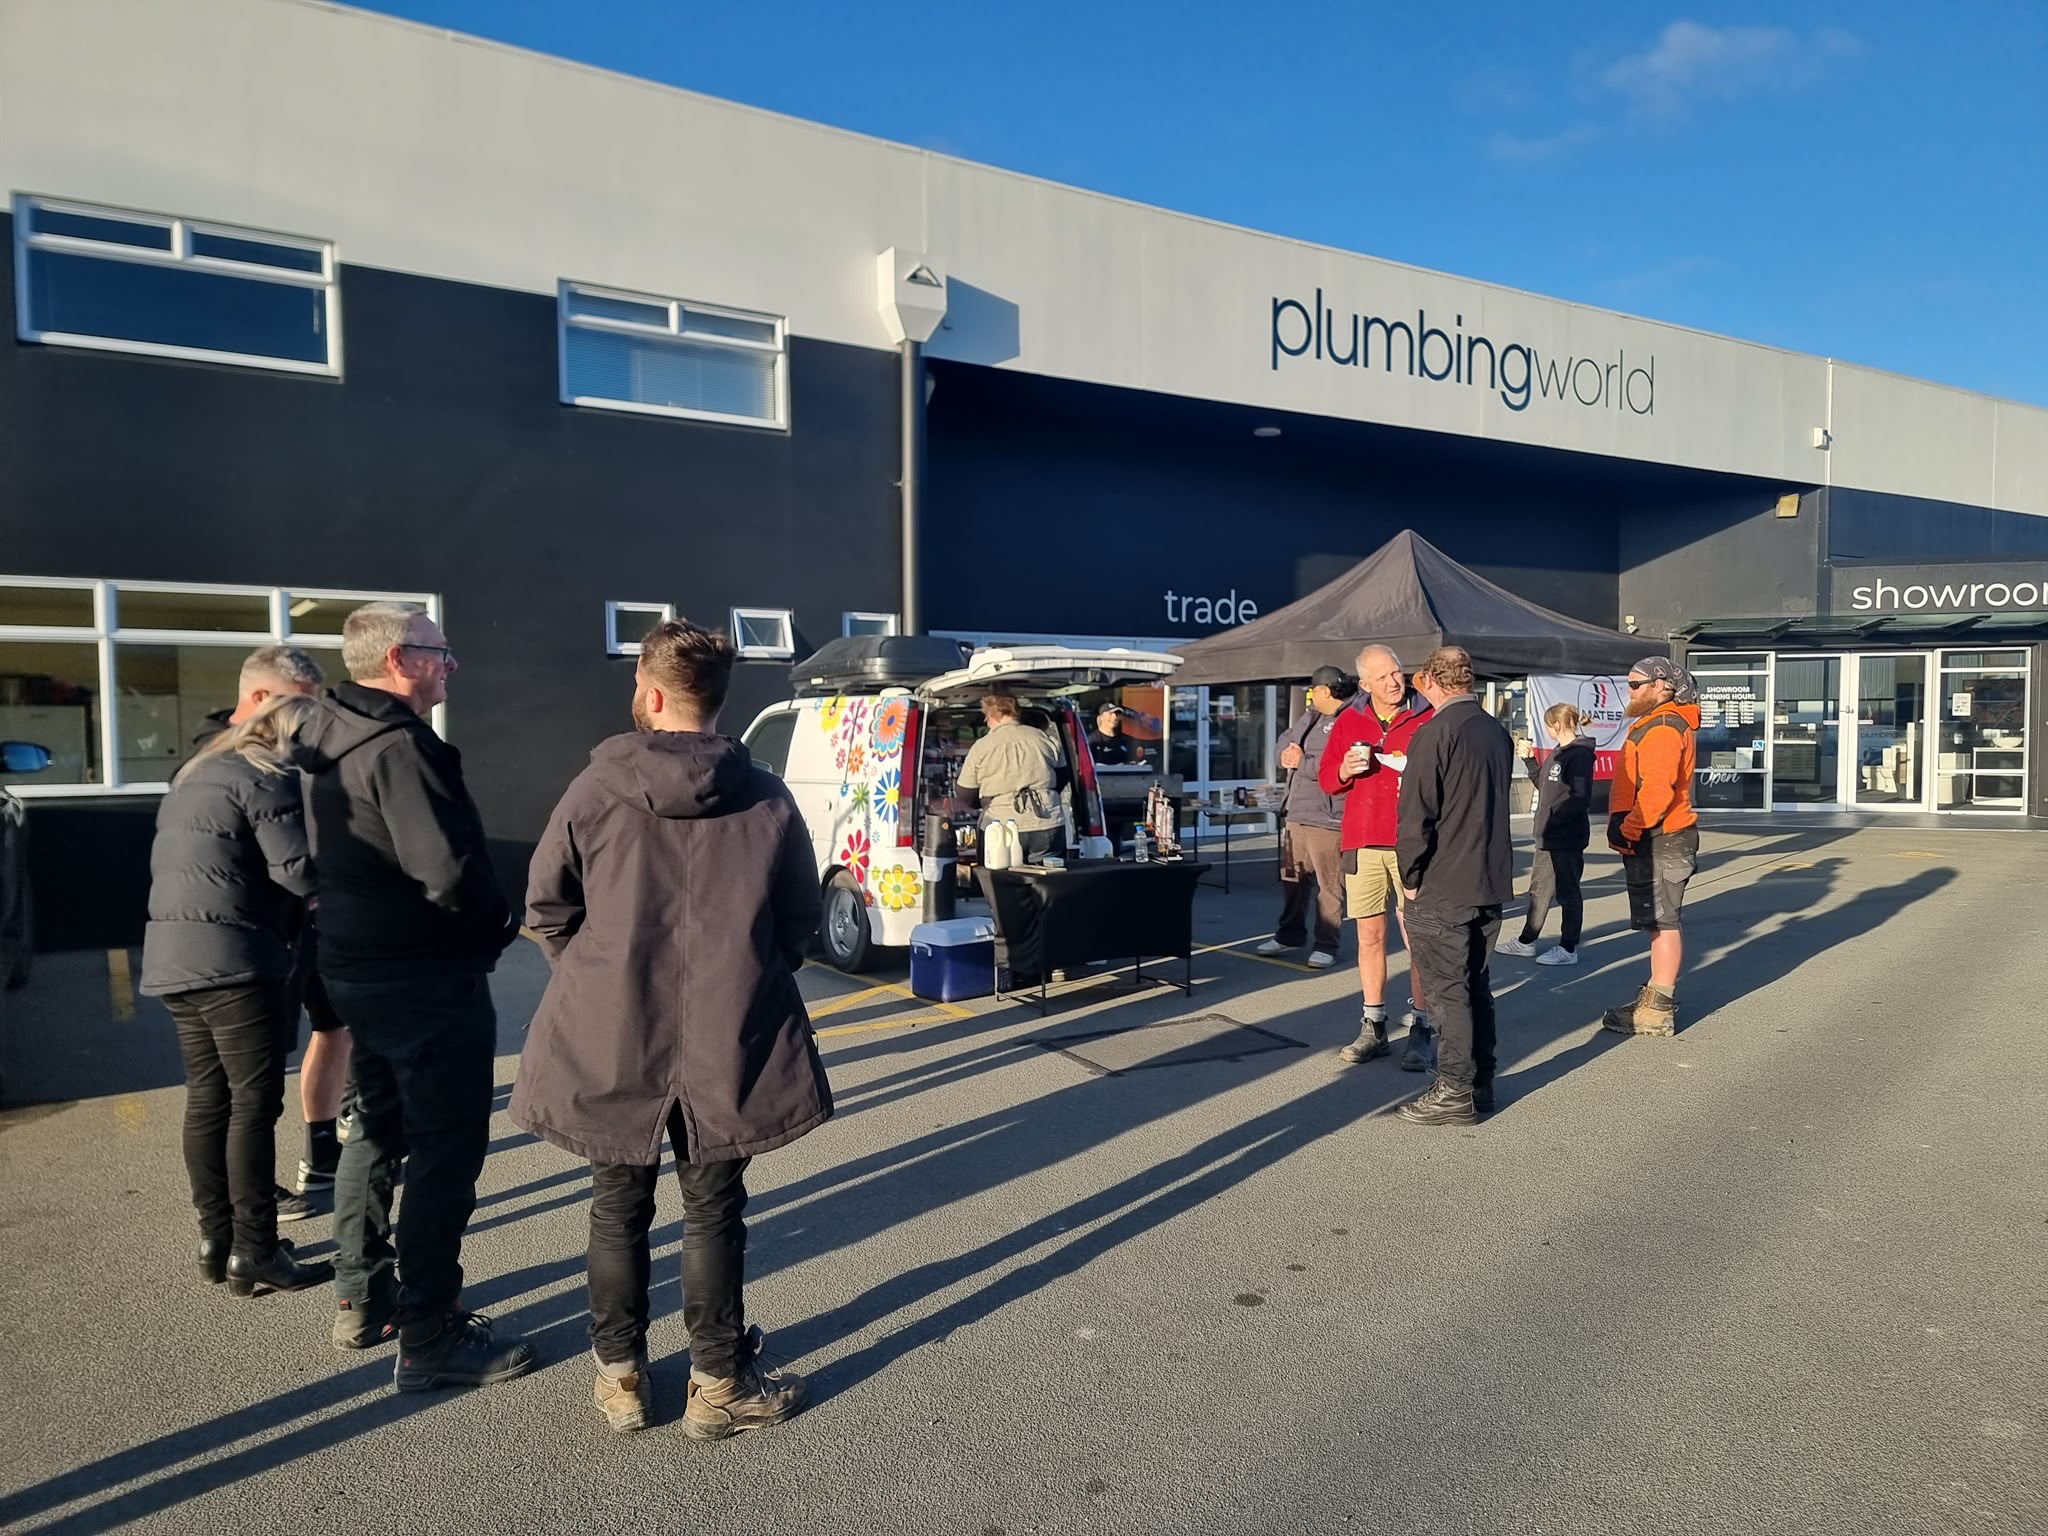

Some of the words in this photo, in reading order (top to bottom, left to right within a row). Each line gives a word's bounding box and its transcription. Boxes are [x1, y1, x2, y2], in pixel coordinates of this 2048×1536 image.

[1164, 589, 1258, 625] trade
[1581, 709, 1623, 721] MATES
[1700, 766, 1740, 788] Open
